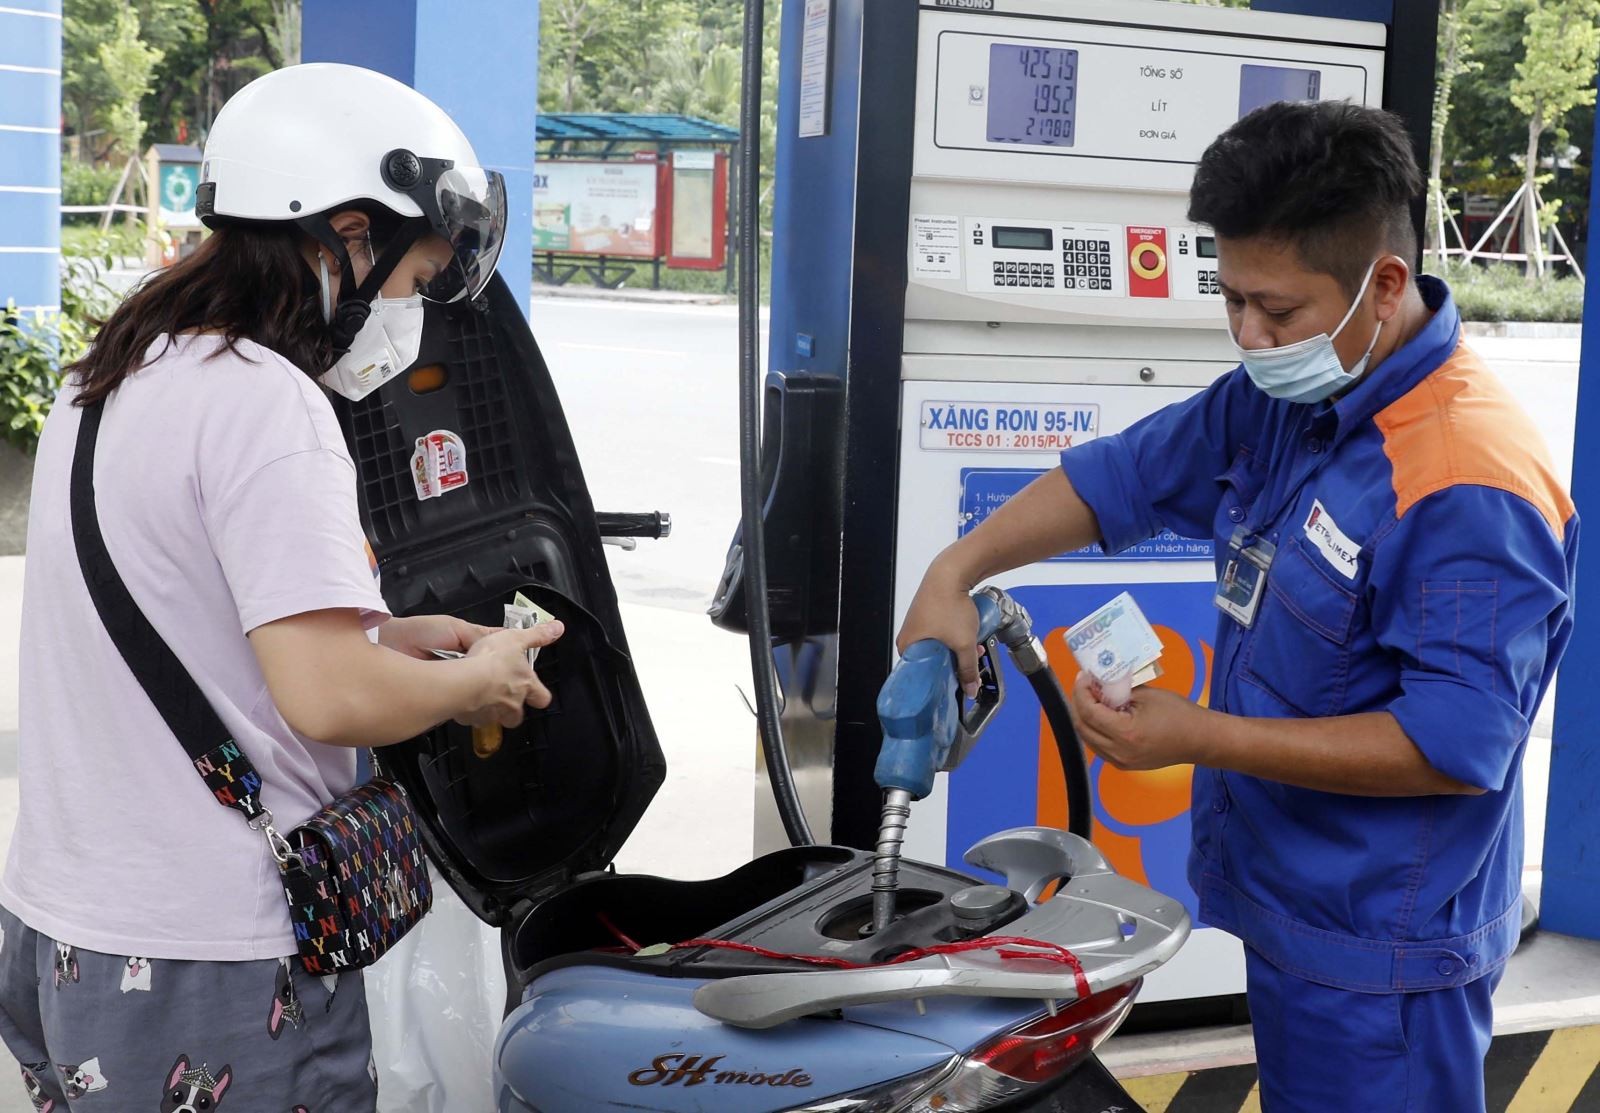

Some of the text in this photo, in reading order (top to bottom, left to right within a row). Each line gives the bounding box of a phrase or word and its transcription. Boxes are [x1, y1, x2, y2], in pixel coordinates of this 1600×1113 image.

[1020, 49, 1074, 80] 42515
[1140, 65, 1184, 80] TỔNG SỐ
[1307, 72, 1317, 99] 0
[1151, 99, 1168, 112] LÍT
[1026, 117, 1072, 138] 21780
[1139, 130, 1177, 140] ĐƠN GIÁ
[928, 405, 1093, 432] XĂNG RON 95-IV
[947, 432, 982, 447] TCCS
[986, 434, 1001, 447] 01
[1013, 434, 1073, 449] 2015/PLX
[1155, 543, 1184, 553] khách
[628, 1053, 814, 1088] SH mode
